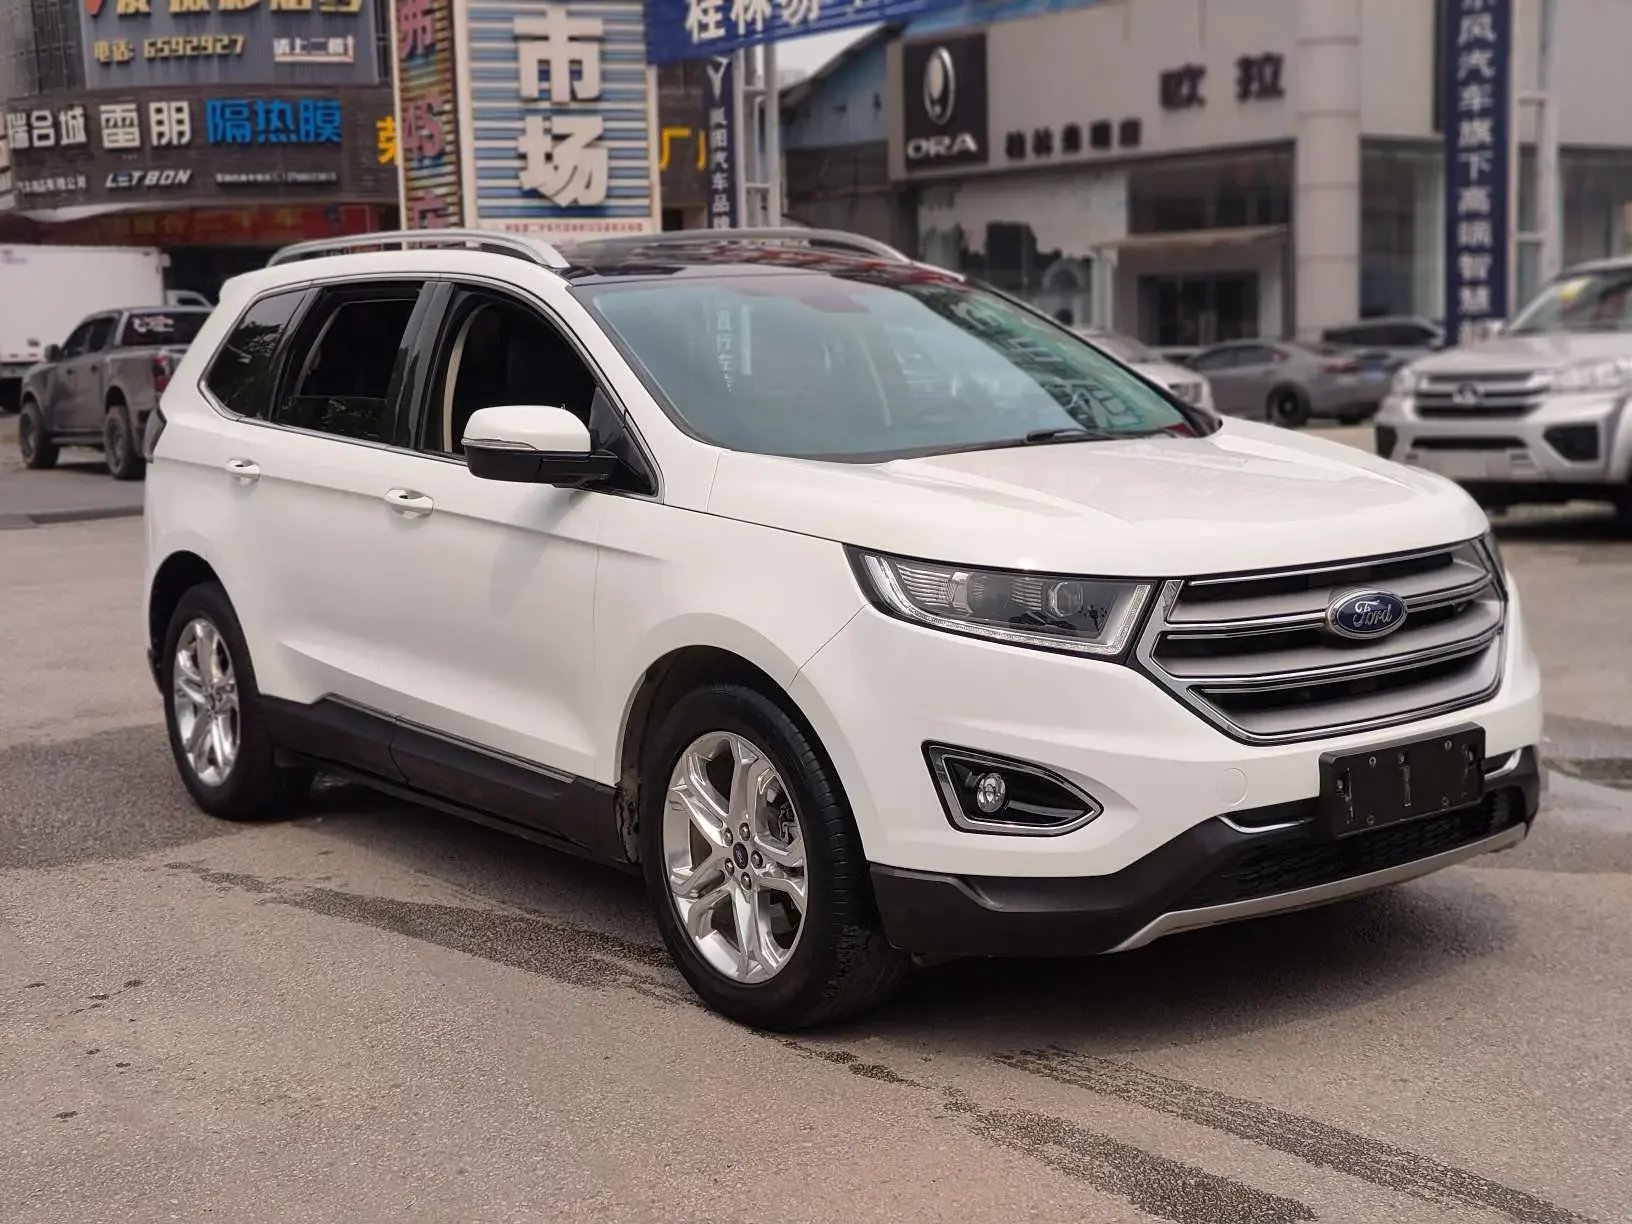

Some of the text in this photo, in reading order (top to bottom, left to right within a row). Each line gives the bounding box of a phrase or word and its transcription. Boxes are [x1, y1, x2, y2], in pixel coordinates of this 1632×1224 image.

[143, 34, 245, 58] 6592927
[513, 5, 609, 208] 市场
[100, 101, 191, 148] 雷朋
[206, 98, 342, 144] 隔热膜
[907, 132, 978, 159] ORA
[1352, 600, 1393, 628] Ford
